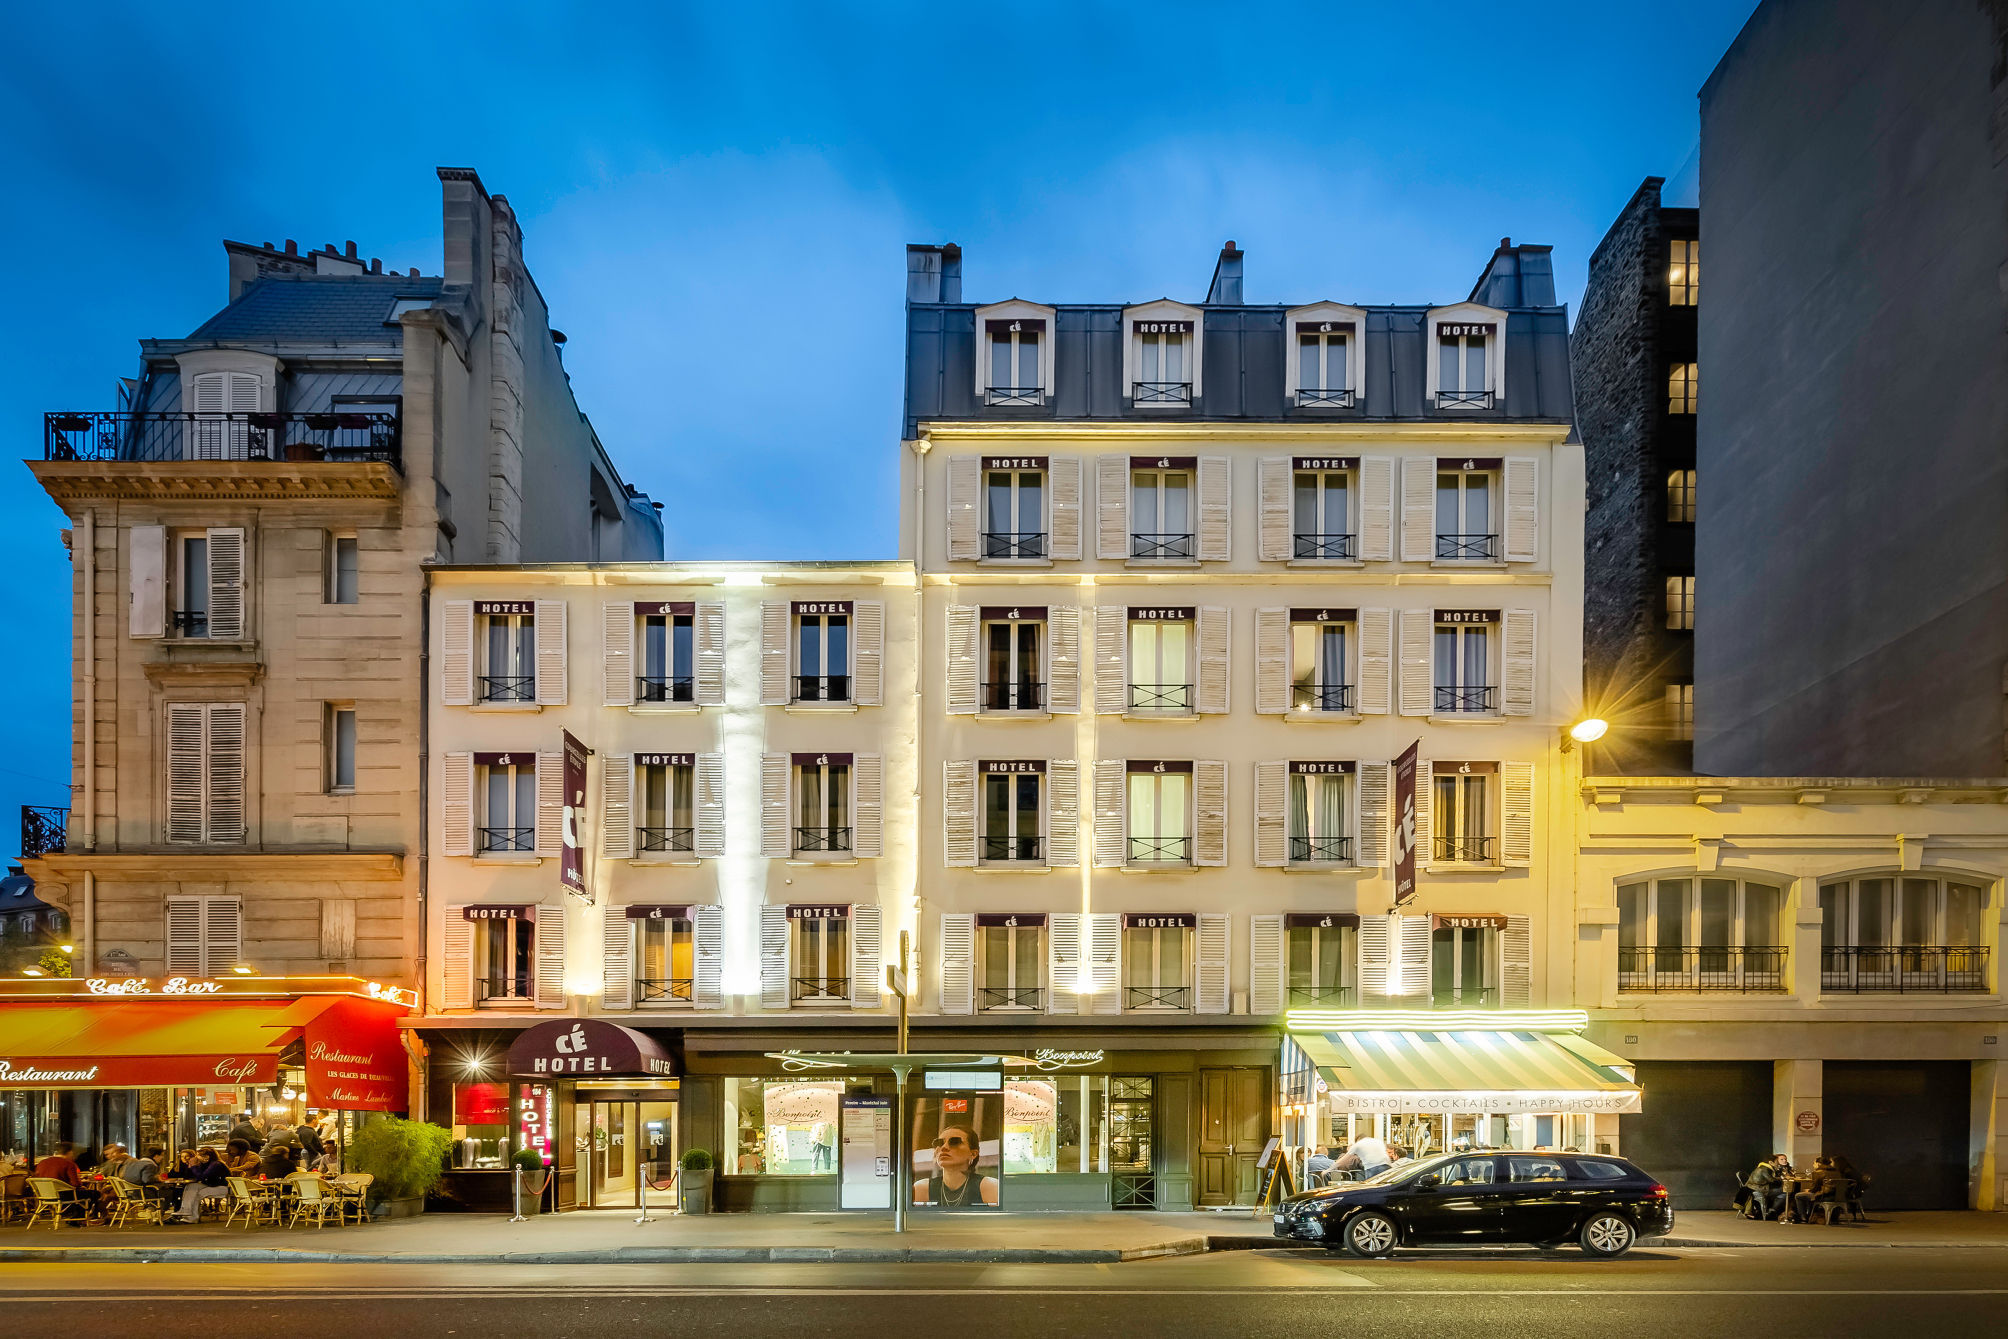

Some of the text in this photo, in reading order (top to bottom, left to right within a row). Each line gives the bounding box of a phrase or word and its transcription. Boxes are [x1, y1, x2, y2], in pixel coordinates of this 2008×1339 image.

[1140, 323, 1186, 333] HOTEL
[1442, 325, 1488, 336] HOTEL
[992, 458, 1038, 469] HOTEL
[1301, 459, 1349, 470] HOTEL
[483, 603, 531, 614] HOTEL
[799, 603, 846, 613] HOTEL
[1138, 609, 1185, 620] HOTEL
[1443, 612, 1489, 623] HOTEL
[642, 755, 689, 765] HOTEL
[989, 762, 1036, 772] HOTEL
[1298, 763, 1346, 774] HOTEL
[469, 909, 518, 919] HOTEL
[793, 908, 841, 919] HOTEL
[1137, 917, 1185, 928] HOTEL
[1450, 917, 1499, 928] HOTEL
[86, 977, 224, 994] Café Bar
[555, 1023, 588, 1054] CÉ
[310, 1040, 374, 1065] Restaurant
[1035, 1048, 1105, 1067] Bonpoint
[534, 1056, 612, 1073] HOTEL
[650, 1057, 671, 1075] HOTEL
[212, 1057, 257, 1084] Café
[327, 1070, 338, 1078] LES
[339, 1071, 359, 1079] GLACES
[1348, 1099, 1623, 1108] BISTRO COCKTAILS HAPPY HOURS
[767, 1107, 823, 1120] Bonpoint
